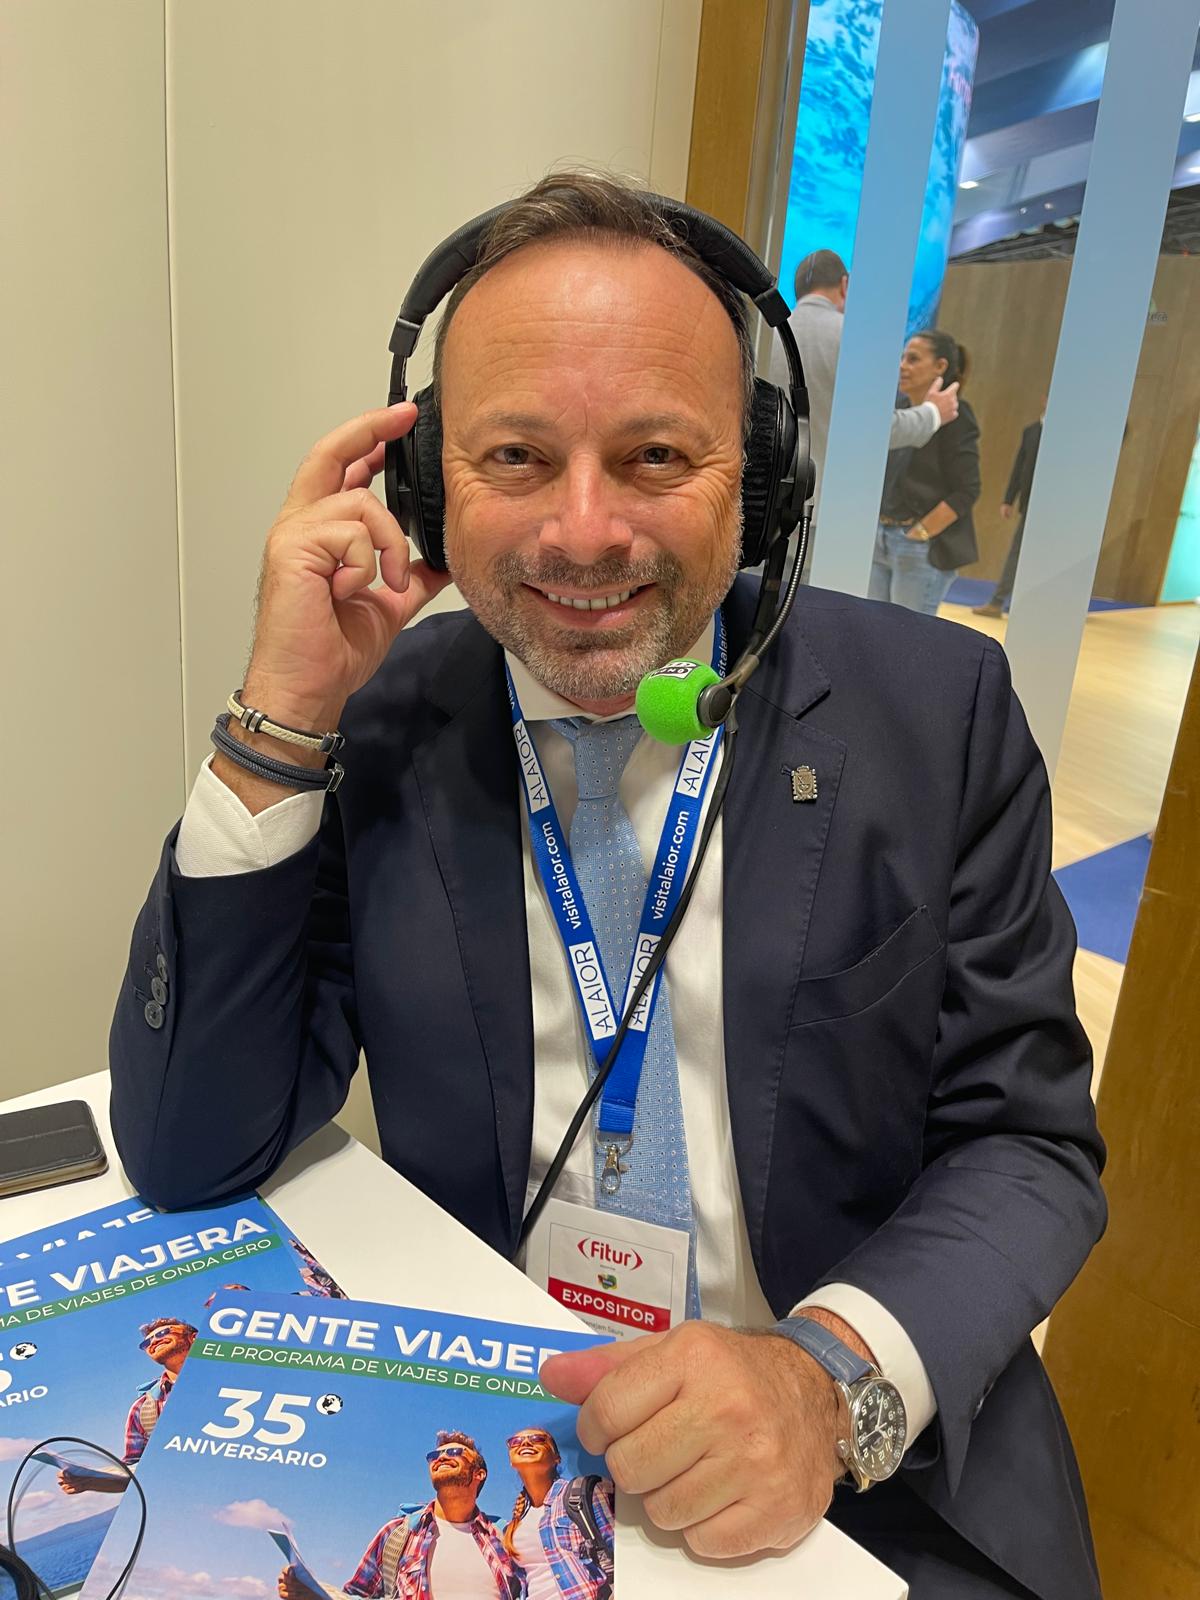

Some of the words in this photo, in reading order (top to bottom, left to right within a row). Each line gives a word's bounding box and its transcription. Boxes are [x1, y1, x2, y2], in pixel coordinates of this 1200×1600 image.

[514, 723, 547, 806] ALAIOR
[682, 732, 715, 792] ALAI
[541, 821, 582, 930] visitalaior.com
[652, 810, 690, 920] visitalaior.com
[574, 945, 614, 1034] ALAIOR
[26, 1304, 55, 1321] DE
[58, 1284, 127, 1311] VIAJES
[130, 1275, 159, 1292] DE
[161, 1255, 220, 1280] ONDA
[222, 1238, 272, 1262] CERO
[50, 1217, 270, 1293] VIAJERA
[590, 1240, 632, 1267] Fitur
[208, 1307, 380, 1352] GENTE
[393, 1325, 563, 1376] VIAJE
[561, 1288, 656, 1326] EXPOSITOR
[202, 1343, 226, 1358] EL
[231, 1346, 346, 1369] PROGRAMA
[351, 1357, 379, 1374] DE
[383, 1362, 449, 1384] VIAJES
[453, 1370, 481, 1389] DE
[486, 1378, 545, 1397] ONDA
[163, 1434, 327, 1469] ANIVERSARIO
